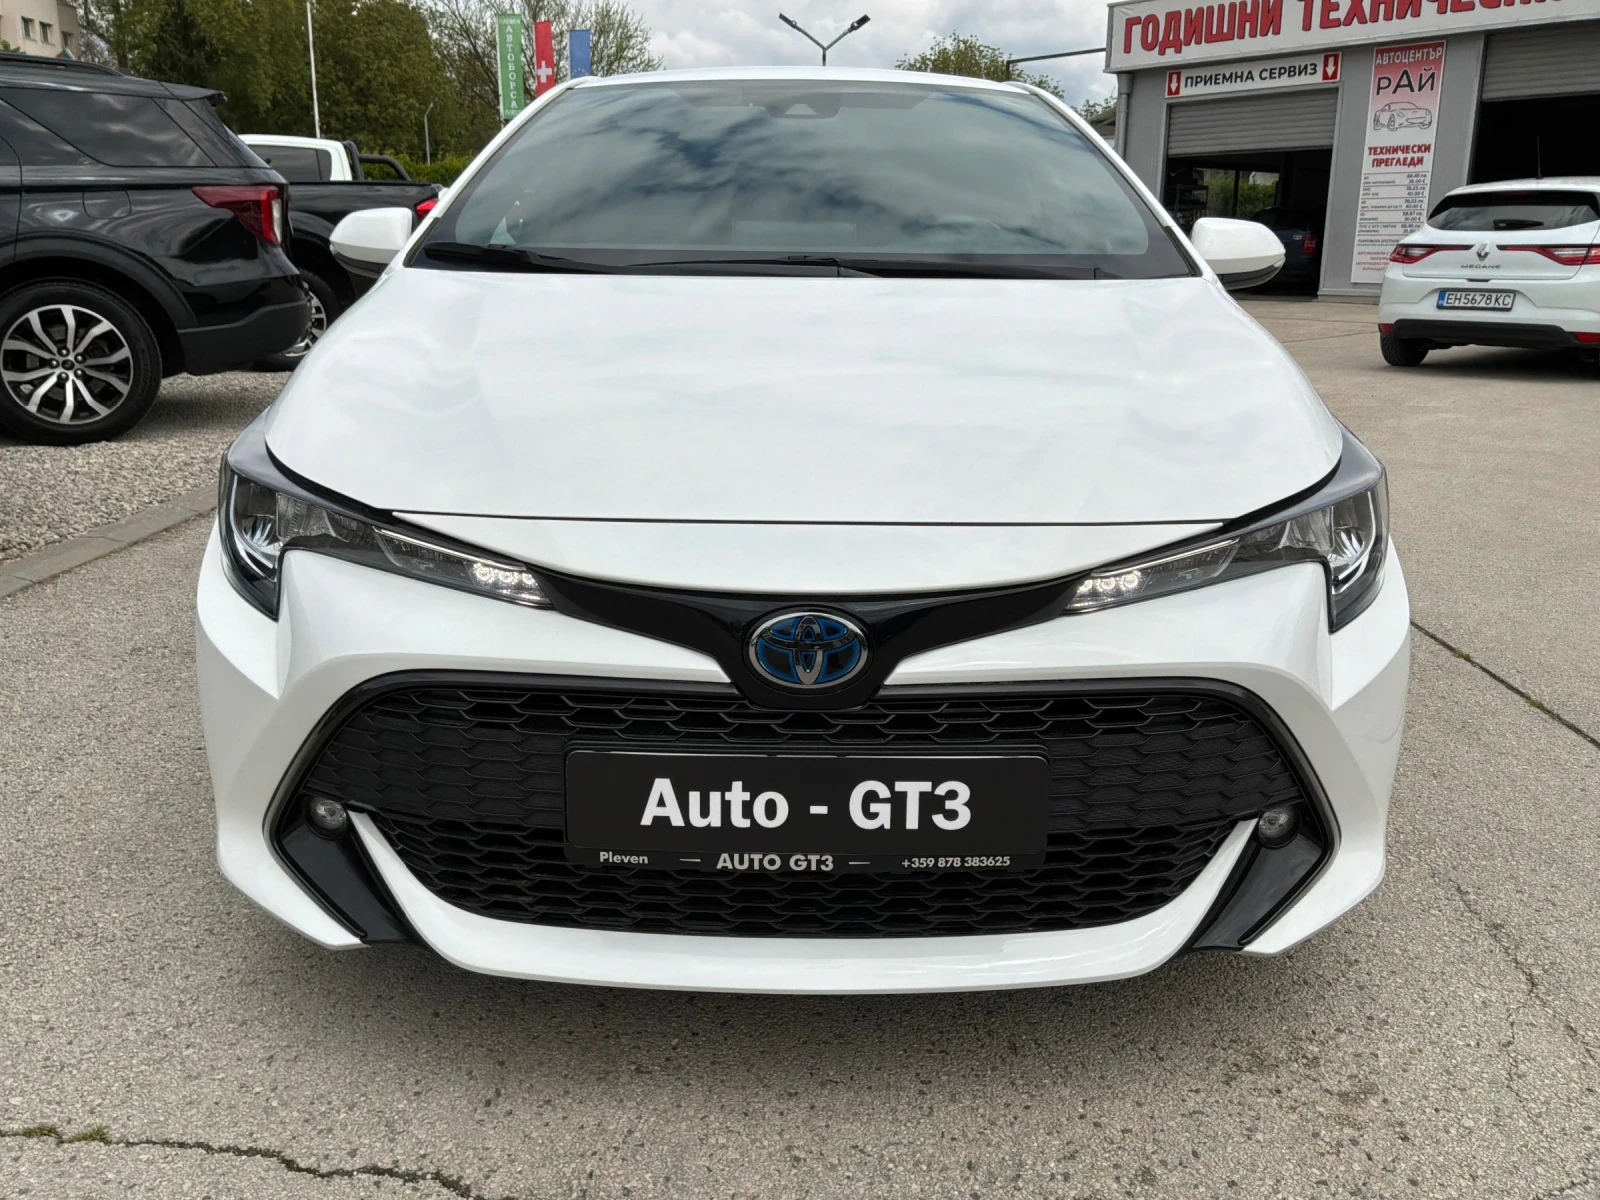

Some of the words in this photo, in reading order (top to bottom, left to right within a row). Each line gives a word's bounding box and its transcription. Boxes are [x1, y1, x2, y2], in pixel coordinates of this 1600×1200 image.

[1123, 0, 1284, 56] ГОДИШНИ
[1375, 47, 1443, 65] АВТОЦЕНТЪР
[1184, 69, 1255, 89] ПРИЕМНА
[1258, 62, 1318, 81] СЕРВИЗ
[1376, 66, 1436, 96] РАЙ
[1367, 143, 1432, 156] ТЕХНИЧЕСКИ
[1371, 156, 1424, 168] ПРЕГЛЕДИ
[640, 777, 789, 828] Auto
[849, 780, 972, 831] GT3
[600, 851, 649, 864] Pleven
[716, 853, 782, 870] AUTO
[789, 854, 834, 871] GT3
[901, 857, 936, 868] +359
[938, 857, 962, 868] 878
[964, 856, 1010, 867] 383625
